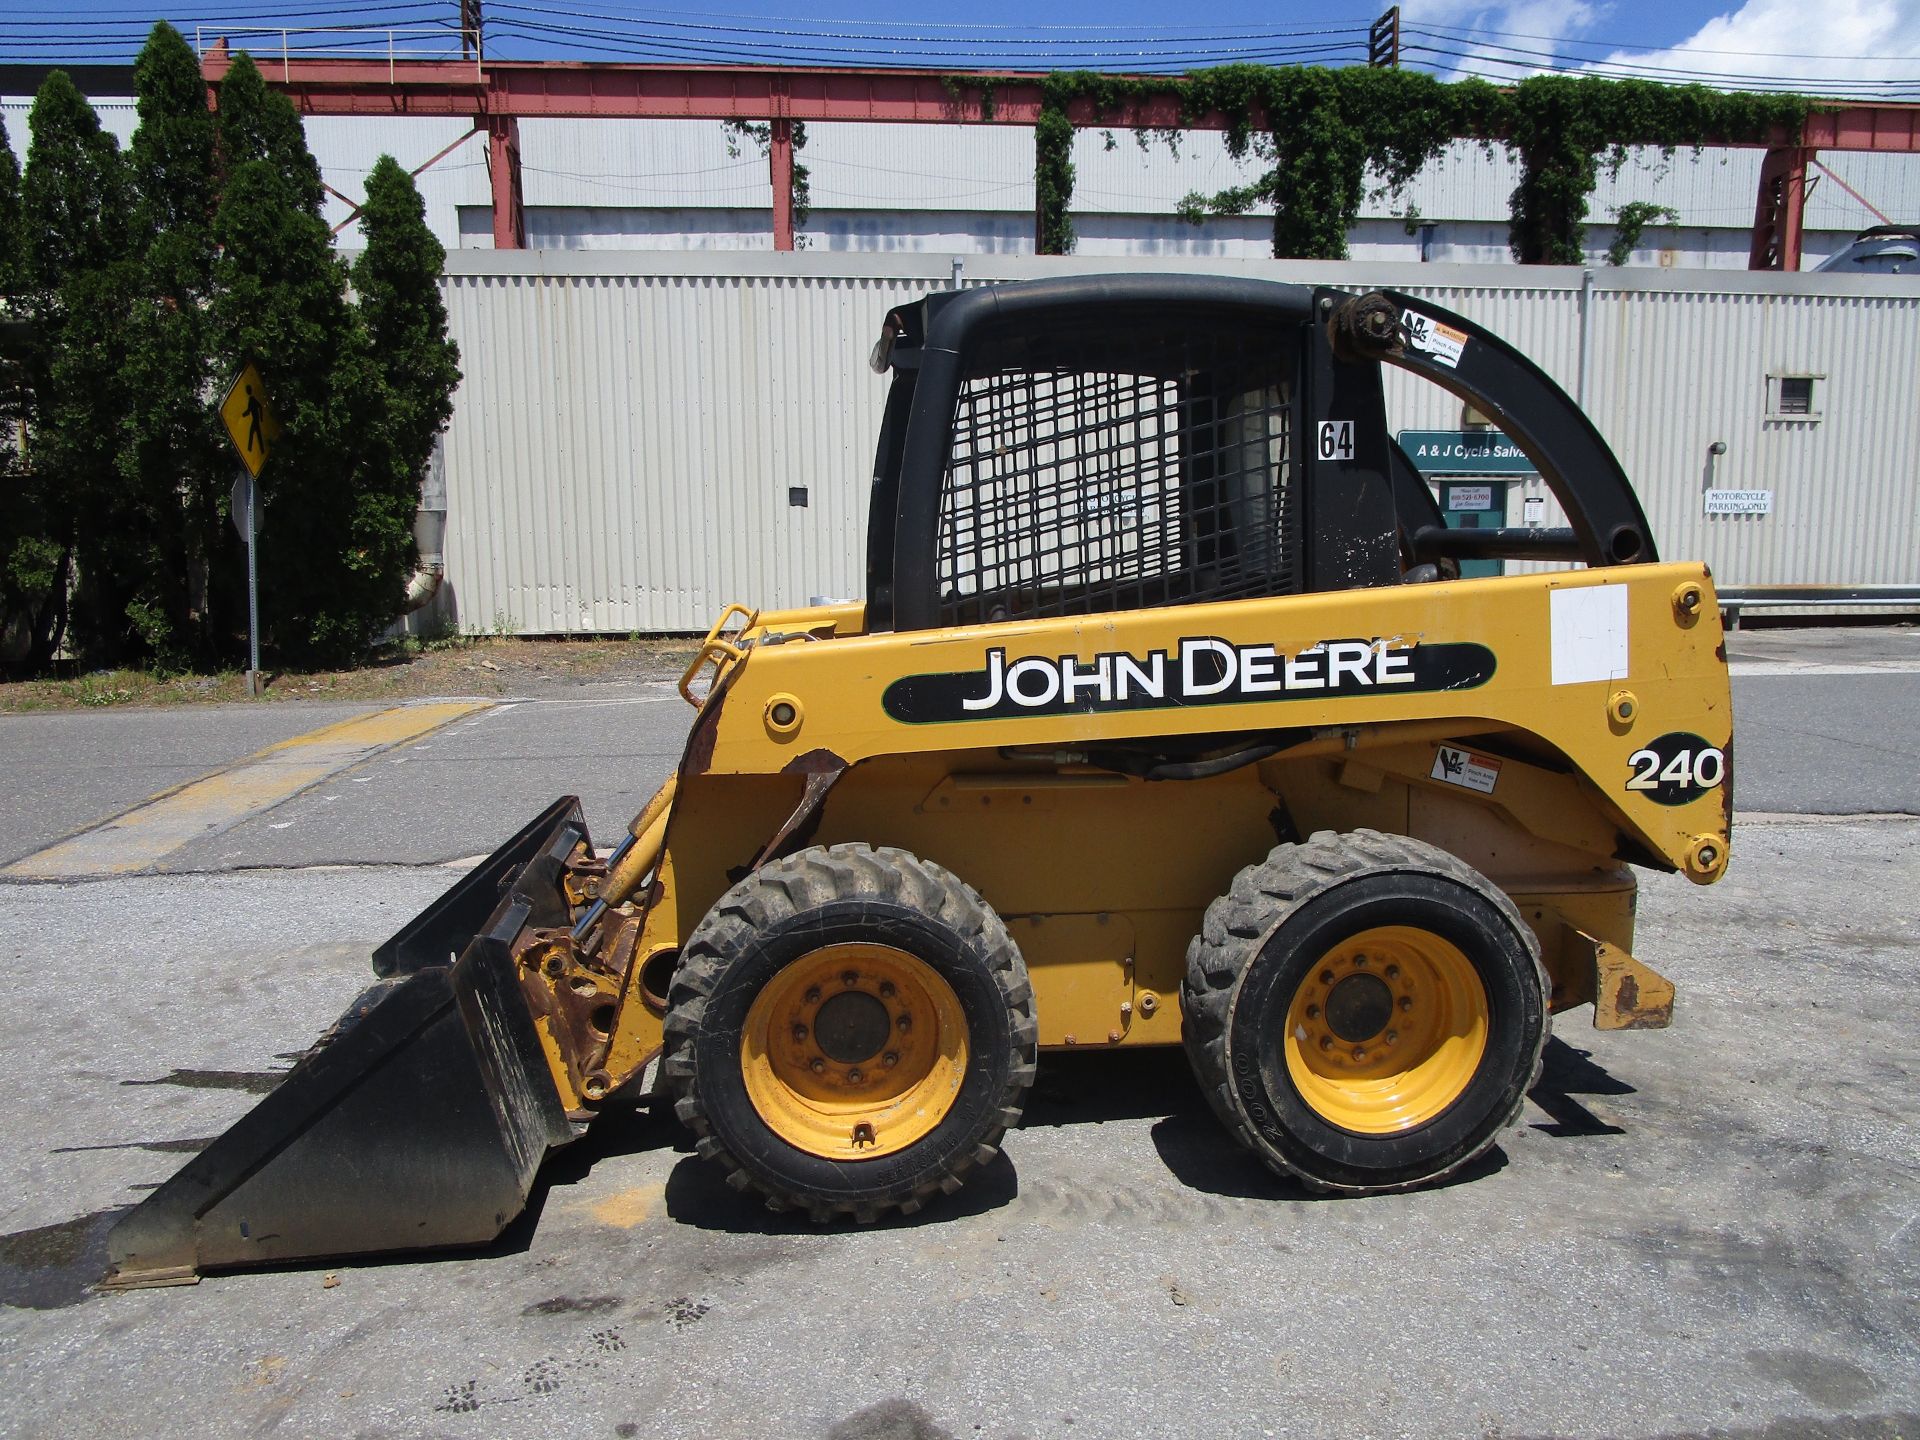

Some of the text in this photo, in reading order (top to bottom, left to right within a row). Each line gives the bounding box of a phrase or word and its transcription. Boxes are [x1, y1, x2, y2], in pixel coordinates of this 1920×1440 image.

[1448, 345, 1459, 354] Area
[1320, 422, 1352, 458] 64
[1416, 444, 1529, 460] A & J Cycle Salva
[1711, 492, 1767, 501] MOTORCYCLE
[1708, 502, 1769, 511] PARKING ONLY
[963, 640, 1416, 712] JOHN DEERE
[1625, 747, 1726, 790] 240
